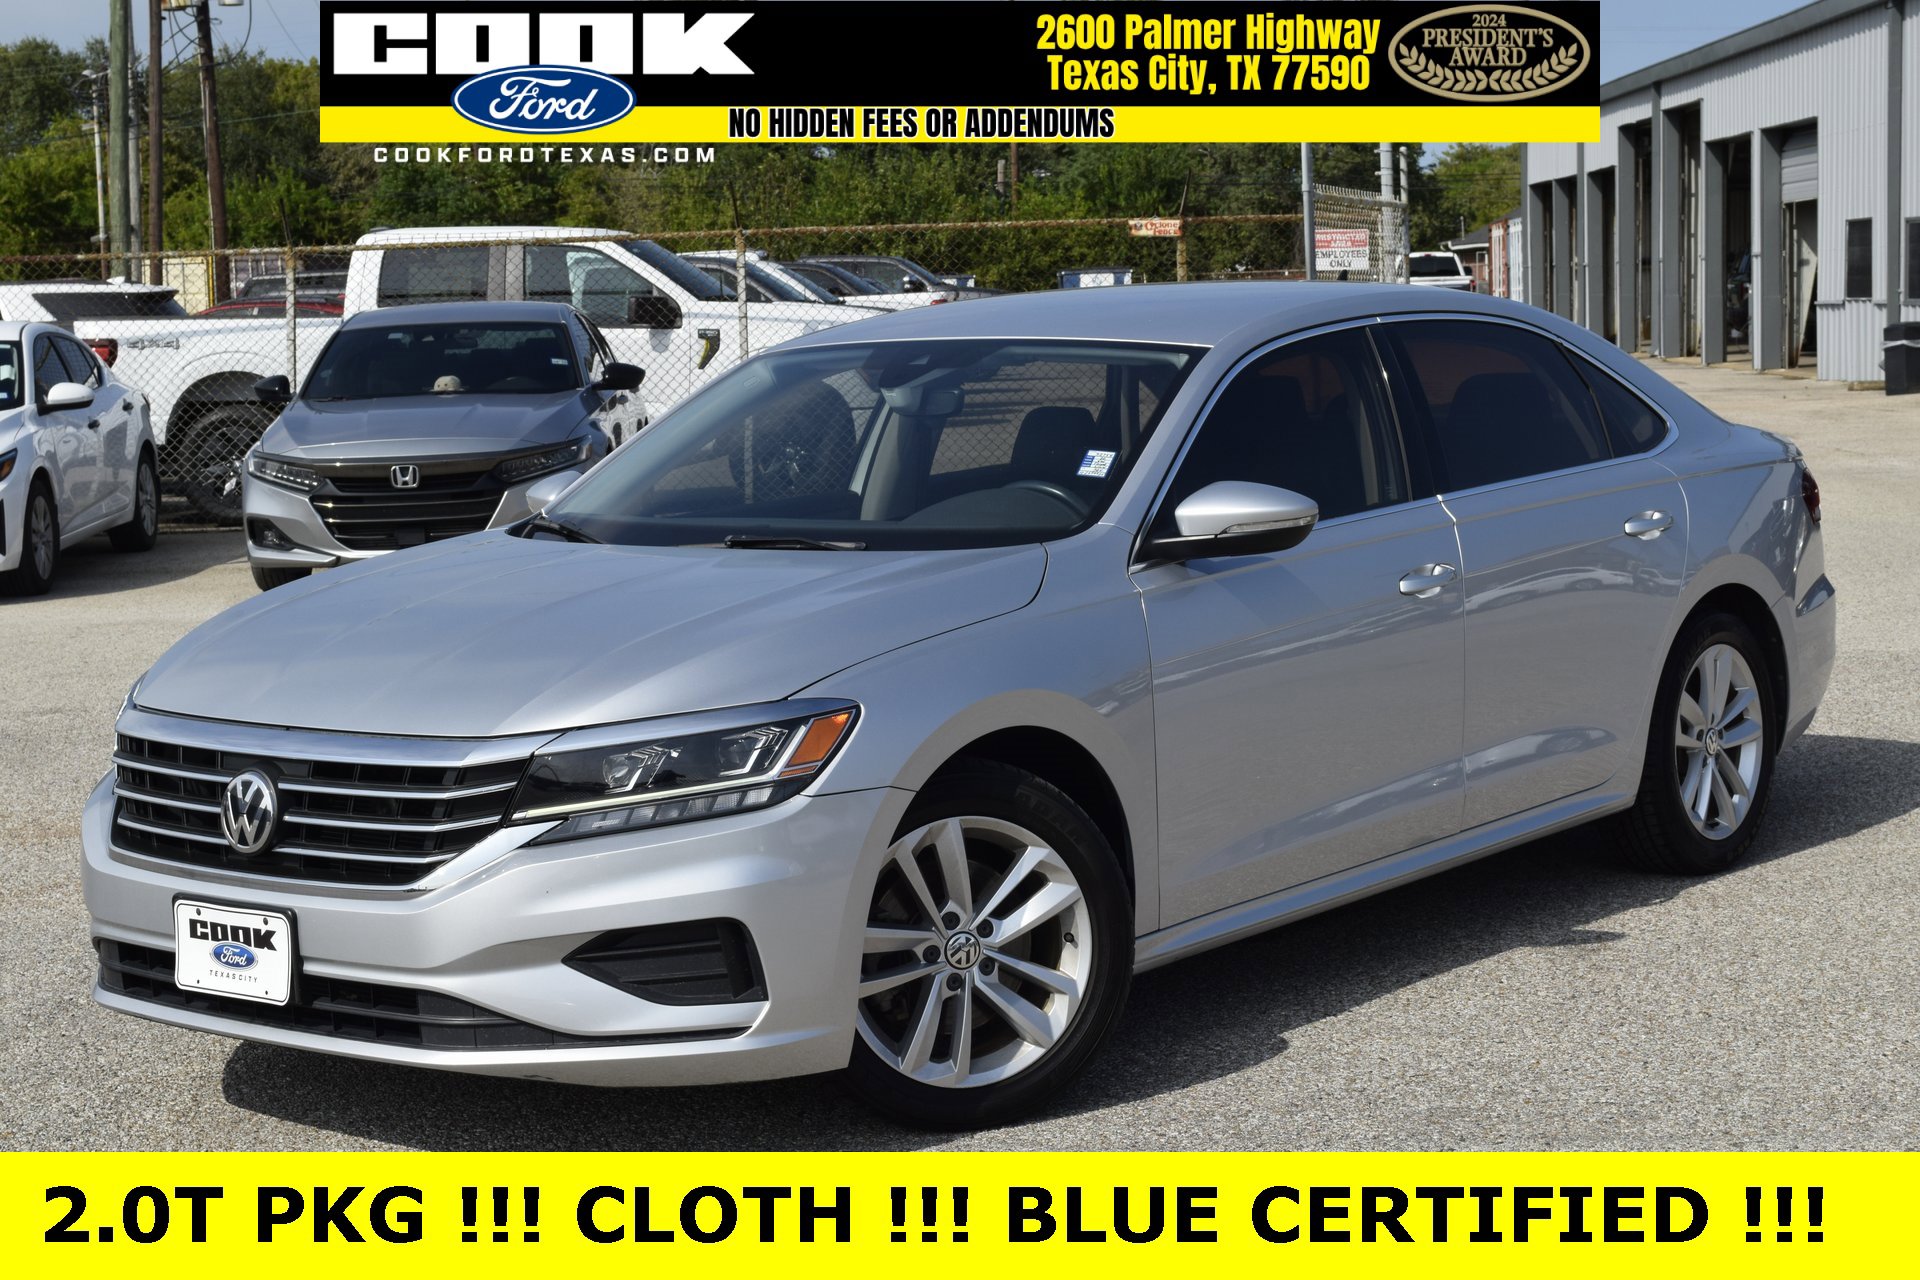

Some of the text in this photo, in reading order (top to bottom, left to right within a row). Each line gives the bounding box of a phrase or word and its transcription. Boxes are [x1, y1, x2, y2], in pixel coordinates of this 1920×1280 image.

[1315, 249, 1368, 260] EMPLOYEES
[1329, 260, 1353, 268] ONLY
[188, 918, 277, 952] COOK
[220, 945, 247, 966] Ford
[209, 969, 259, 983] TEXAS CITY
